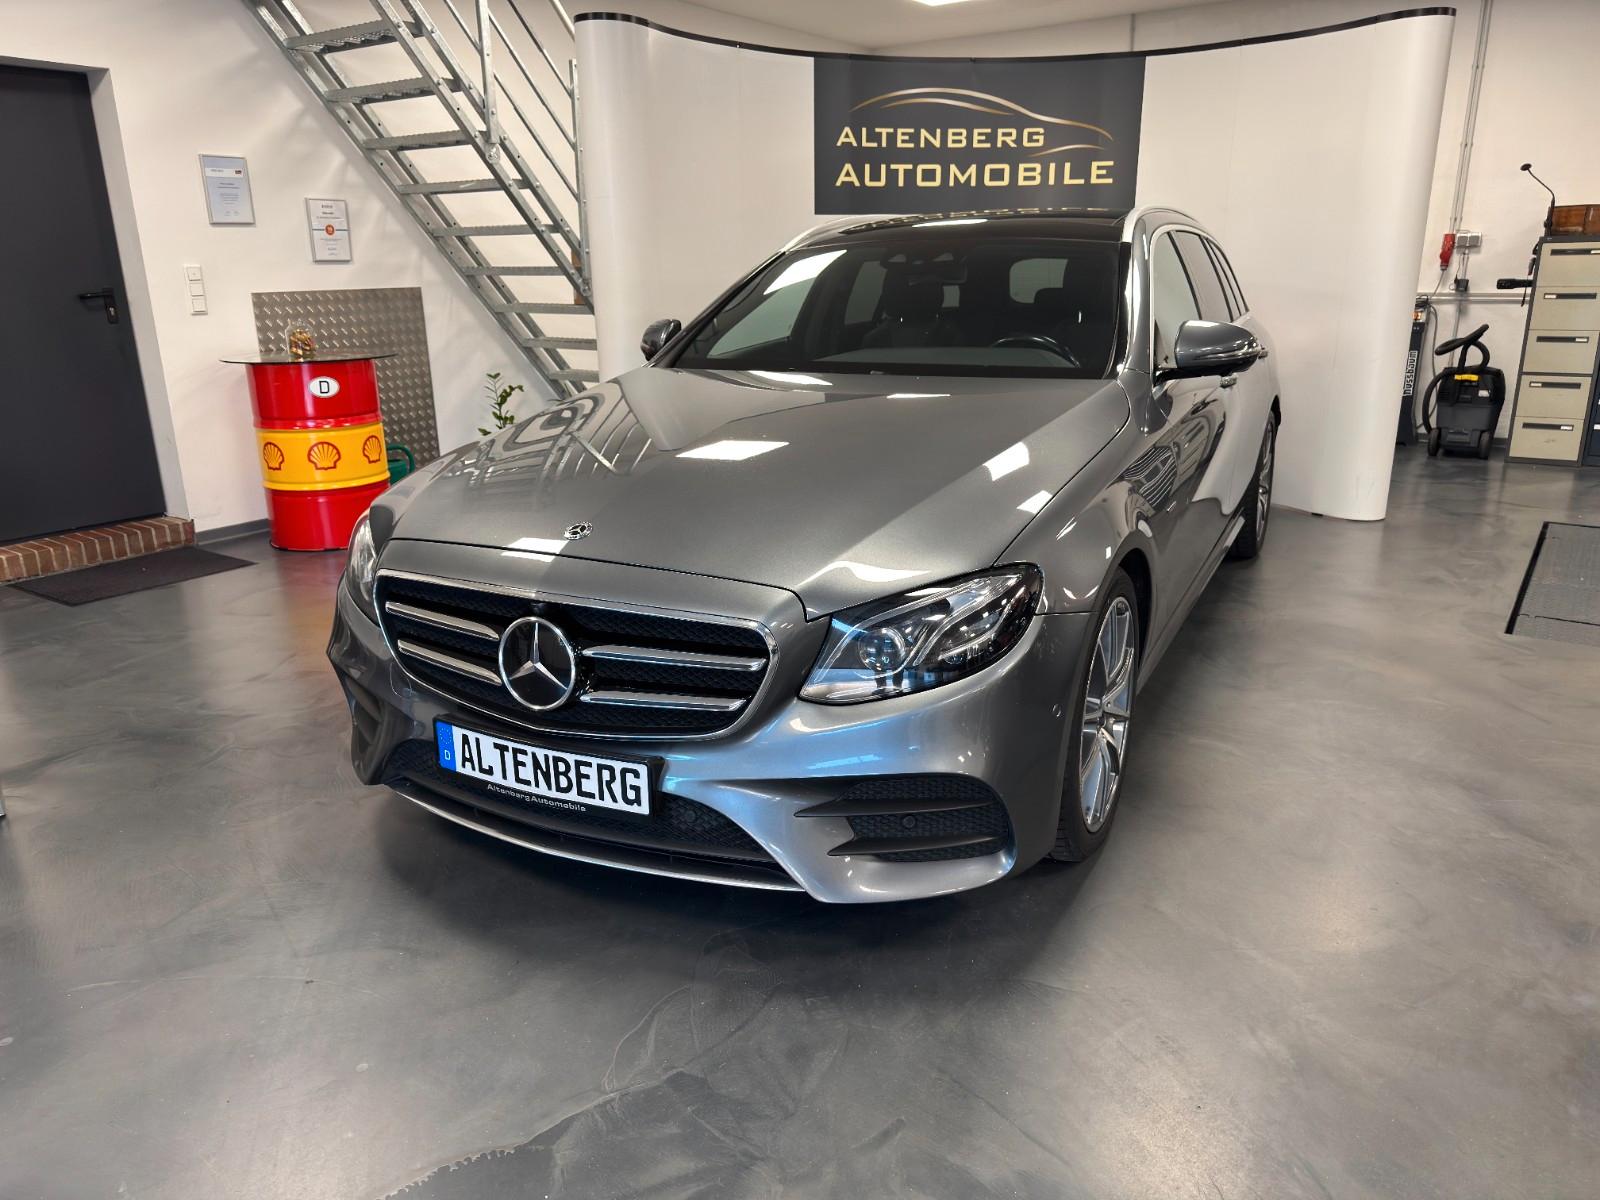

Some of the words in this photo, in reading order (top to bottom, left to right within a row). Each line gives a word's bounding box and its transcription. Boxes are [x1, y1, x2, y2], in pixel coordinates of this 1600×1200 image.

[836, 126, 1045, 148] ALTENBERG
[835, 160, 1114, 187] AUTOMOBILE
[319, 380, 330, 394] D
[444, 749, 451, 761] D
[461, 733, 642, 807] ALTENBERG
